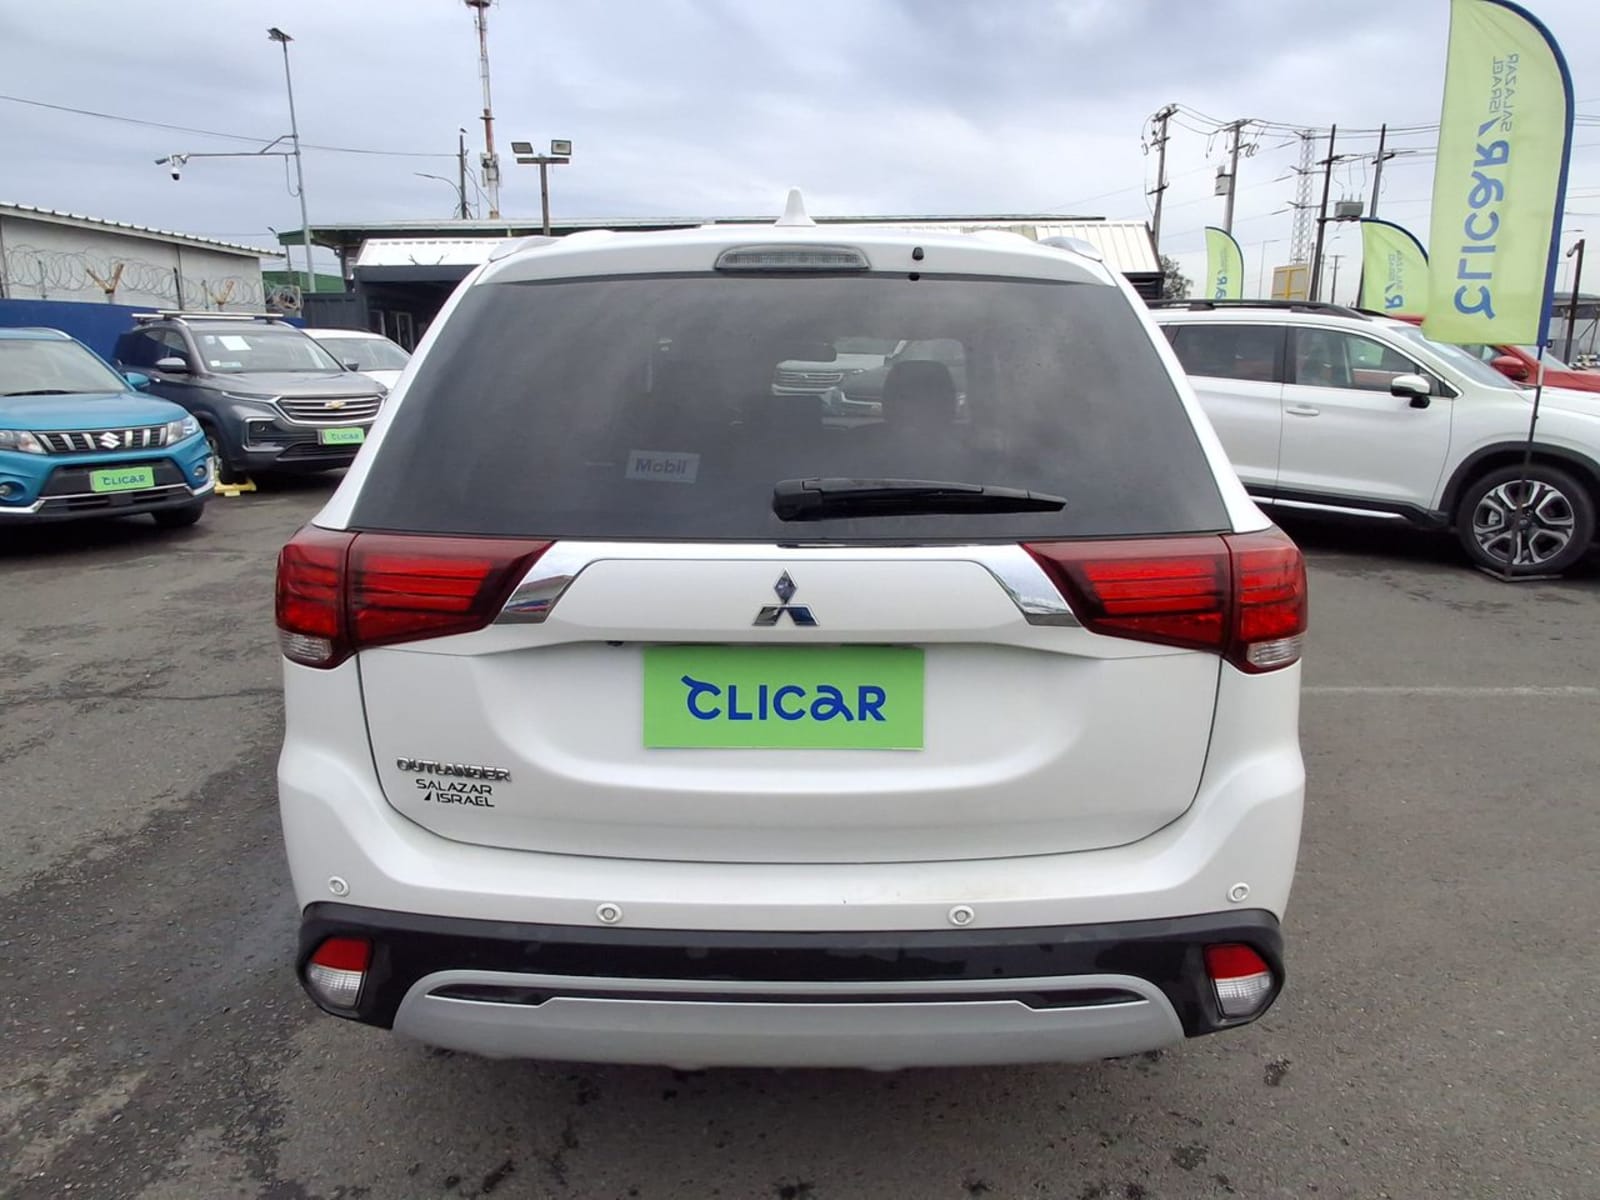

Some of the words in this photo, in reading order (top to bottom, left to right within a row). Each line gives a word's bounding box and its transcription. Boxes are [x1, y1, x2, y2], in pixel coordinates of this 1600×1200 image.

[635, 457, 687, 475] Mobil
[396, 756, 511, 782] OUTLANDER
[415, 778, 493, 796] SALAZAR
[436, 792, 495, 808] ISRAEL
